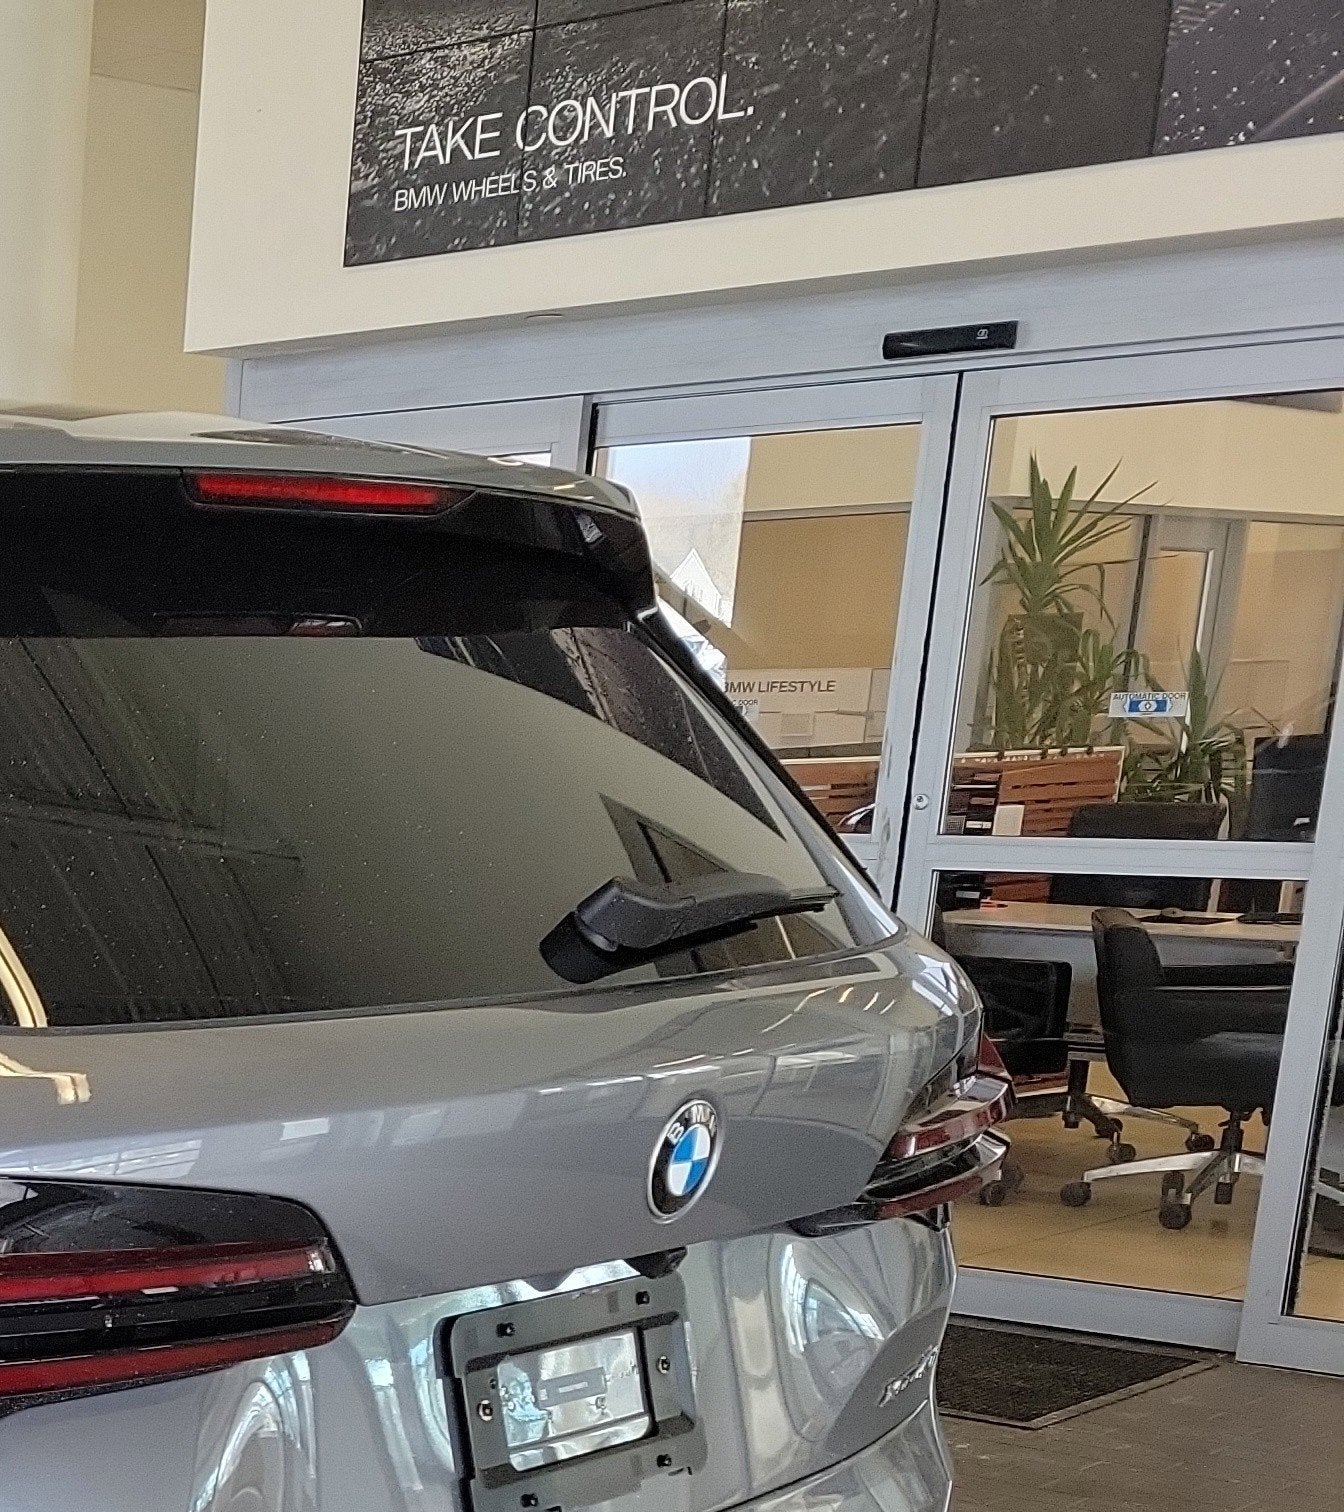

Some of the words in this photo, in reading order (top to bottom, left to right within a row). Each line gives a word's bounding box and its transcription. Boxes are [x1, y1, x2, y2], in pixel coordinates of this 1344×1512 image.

[395, 112, 503, 171] TAKE
[515, 71, 755, 151] CONTROL.
[394, 183, 448, 212] BMW
[452, 171, 537, 202] WHEELS
[544, 168, 558, 189] &
[565, 157, 627, 186] TIRES.
[758, 680, 836, 693] LIFESTYLE
[667, 1104, 718, 1146] BMW
